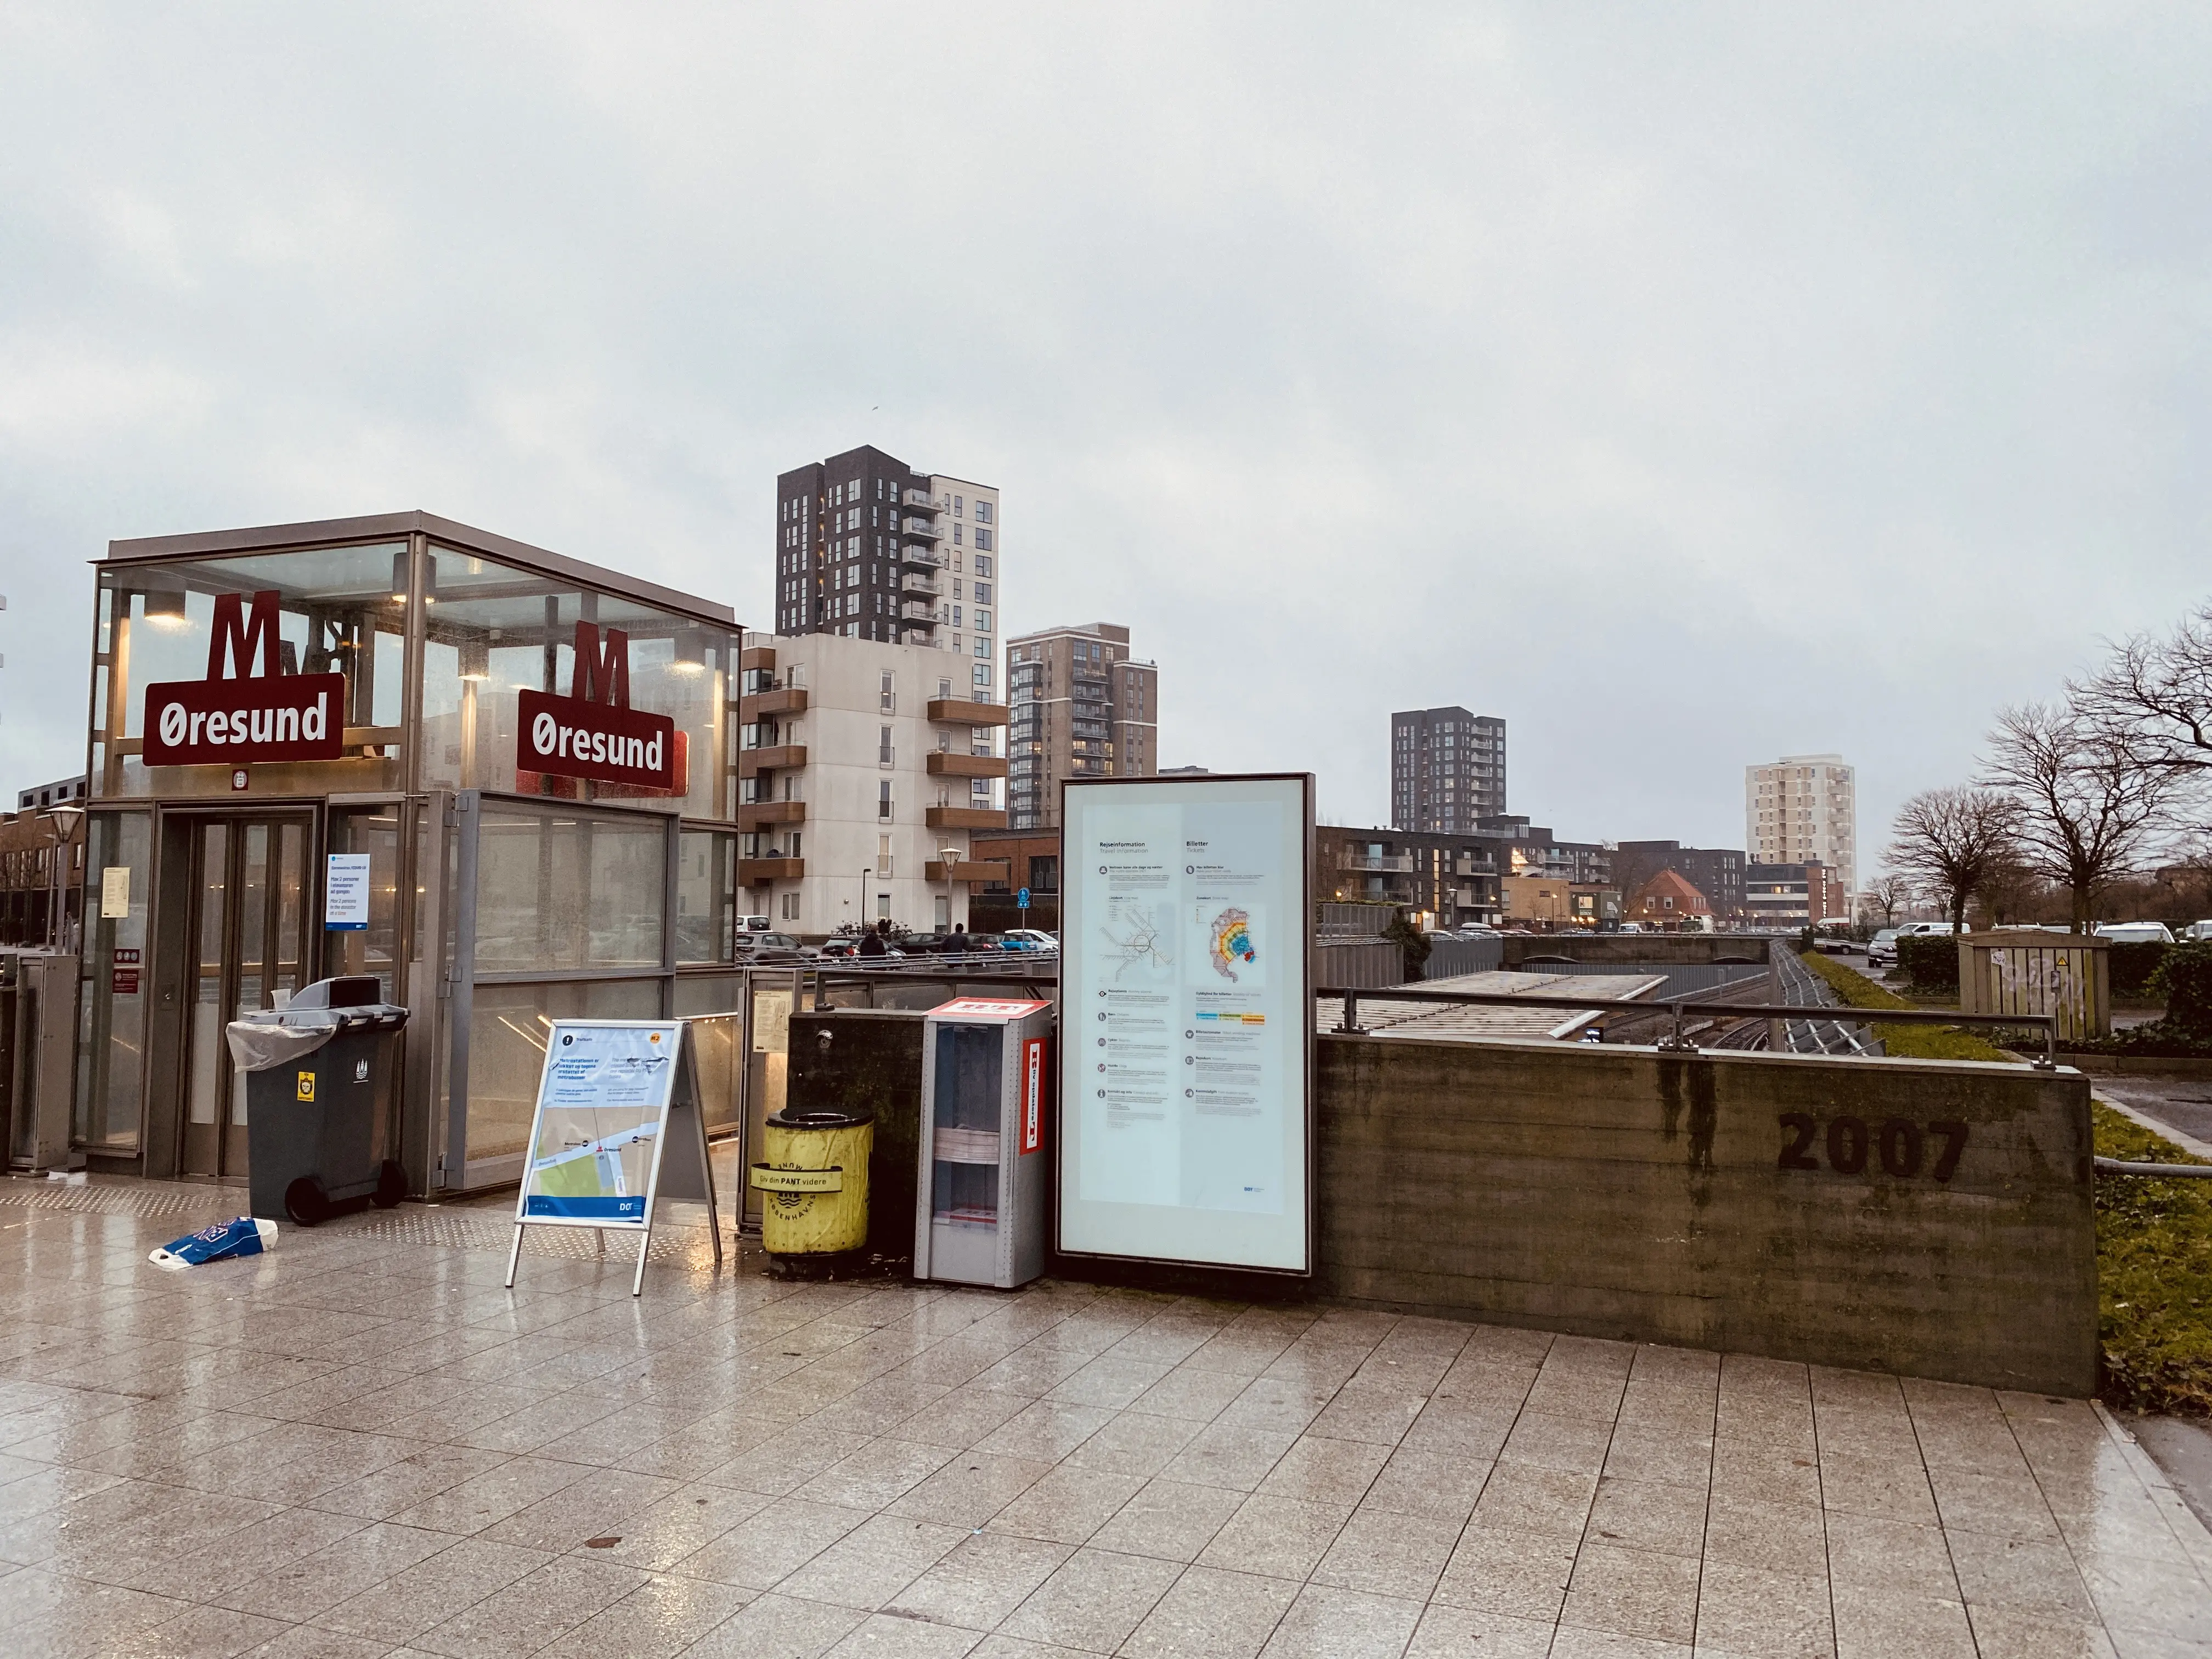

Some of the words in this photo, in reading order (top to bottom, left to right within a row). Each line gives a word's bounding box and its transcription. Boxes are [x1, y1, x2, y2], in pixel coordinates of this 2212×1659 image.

[207, 590, 280, 679] M
[572, 620, 629, 709] M
[160, 692, 328, 747] Øresund
[533, 713, 662, 771] Øresund
[1779, 1113, 1969, 1184] 2007
[619, 1203, 633, 1211] DOT
[769, 1194, 816, 1221] KØBENHAVNS
